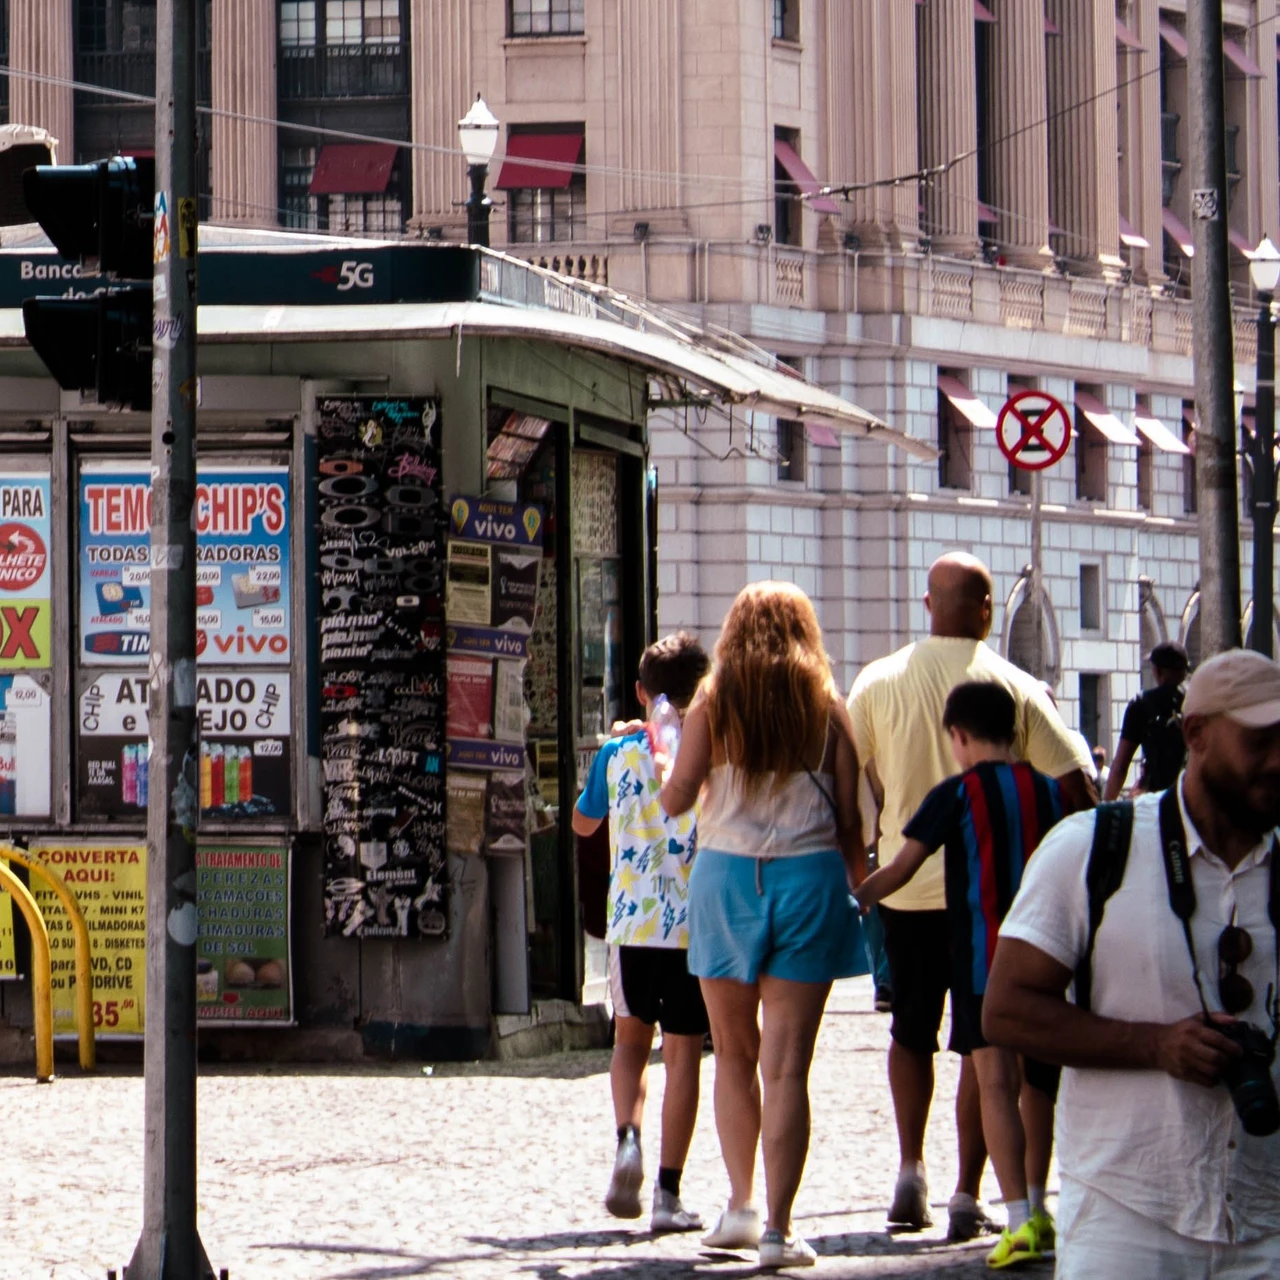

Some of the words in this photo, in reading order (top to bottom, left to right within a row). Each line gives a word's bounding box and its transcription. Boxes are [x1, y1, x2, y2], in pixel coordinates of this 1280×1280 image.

[337, 261, 374, 291] 5G
[2, 488, 44, 518] PARA
[87, 486, 152, 533] TEM
[196, 485, 284, 533] CHIP'S
[474, 514, 516, 540] vivo
[89, 546, 149, 562] TODAS
[196, 545, 280, 562] RADORAS
[256, 570, 280, 581] 22,00
[134, 615, 152, 625] 15,0
[260, 615, 282, 625] 15,00
[214, 625, 288, 653] vivo
[494, 634, 522, 654] vivo
[15, 690, 37, 700] 12,00
[83, 684, 105, 731] CHIP
[255, 683, 281, 729] CHIP
[122, 716, 137, 732] e
[259, 743, 282, 753] 12,00
[491, 747, 519, 765] vivo
[38, 850, 139, 865] CONVERTA
[205, 853, 266, 868] TRATAMENTO
[270, 853, 281, 868] DE
[1169, 840, 1184, 884] Canon
[64, 869, 115, 882] AQUI:
[201, 872, 284, 886] PEREZAS
[75, 890, 100, 900] VHS
[112, 890, 144, 900] VINIL
[100, 906, 127, 916] MINI
[131, 906, 144, 915] K7
[197, 907, 284, 921] CHADURAS
[46, 921, 64, 931] TAS
[88, 921, 145, 931] ILMADORAS
[197, 924, 285, 938] EIMADURAS
[105, 938, 145, 949] DISKETES
[204, 941, 223, 954] DE
[228, 941, 256, 954] SOL
[90, 957, 111, 973] VD,
[116, 957, 132, 970] CD
[51, 978, 65, 989] ou
[200, 1007, 242, 1018] MPRE
